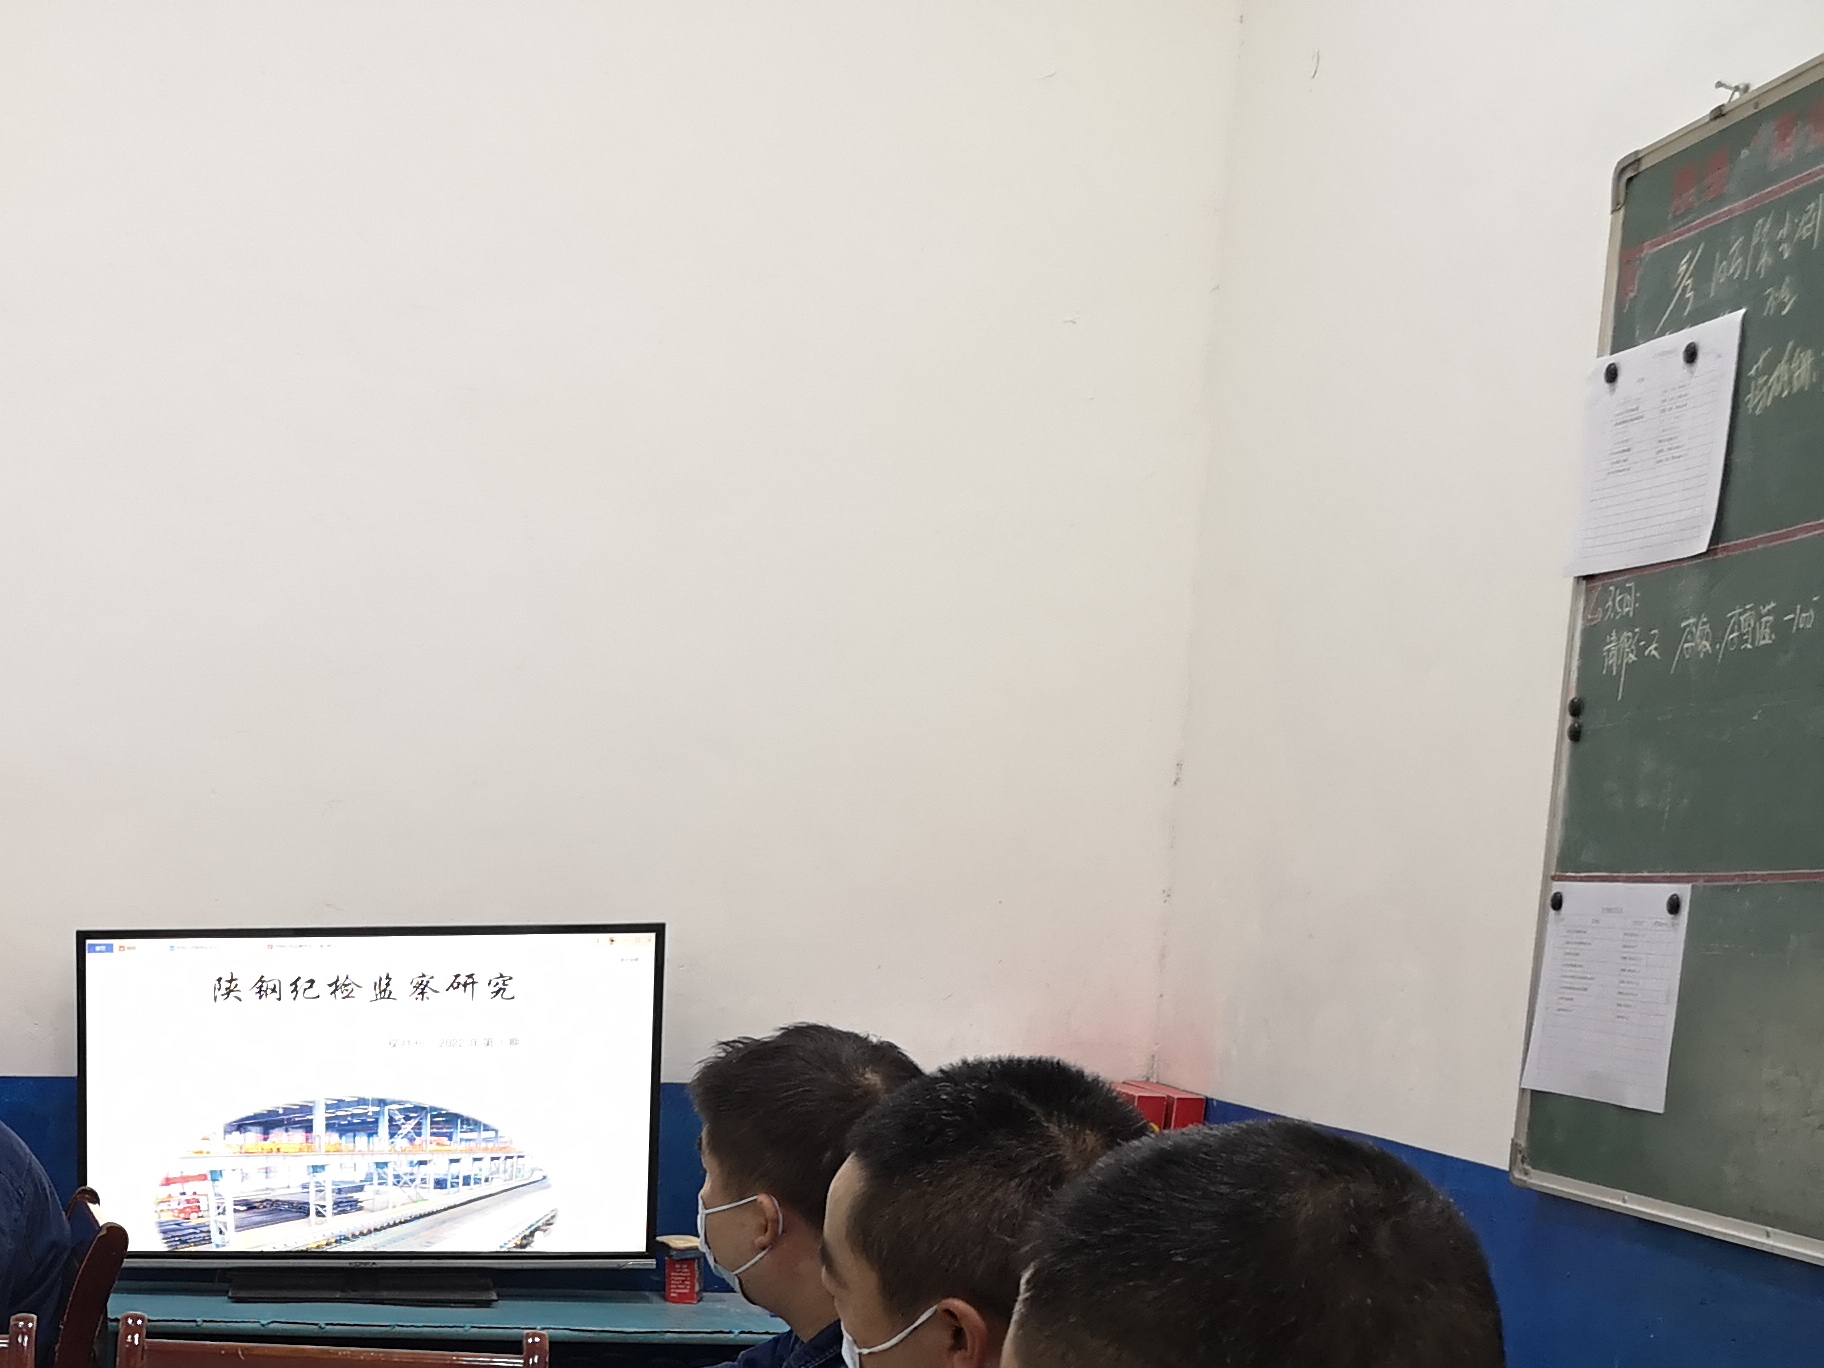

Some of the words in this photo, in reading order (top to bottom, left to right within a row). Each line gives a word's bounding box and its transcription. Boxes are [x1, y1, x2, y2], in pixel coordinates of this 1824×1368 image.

[212, 970, 516, 1003] 陕钢纪检监察研究
